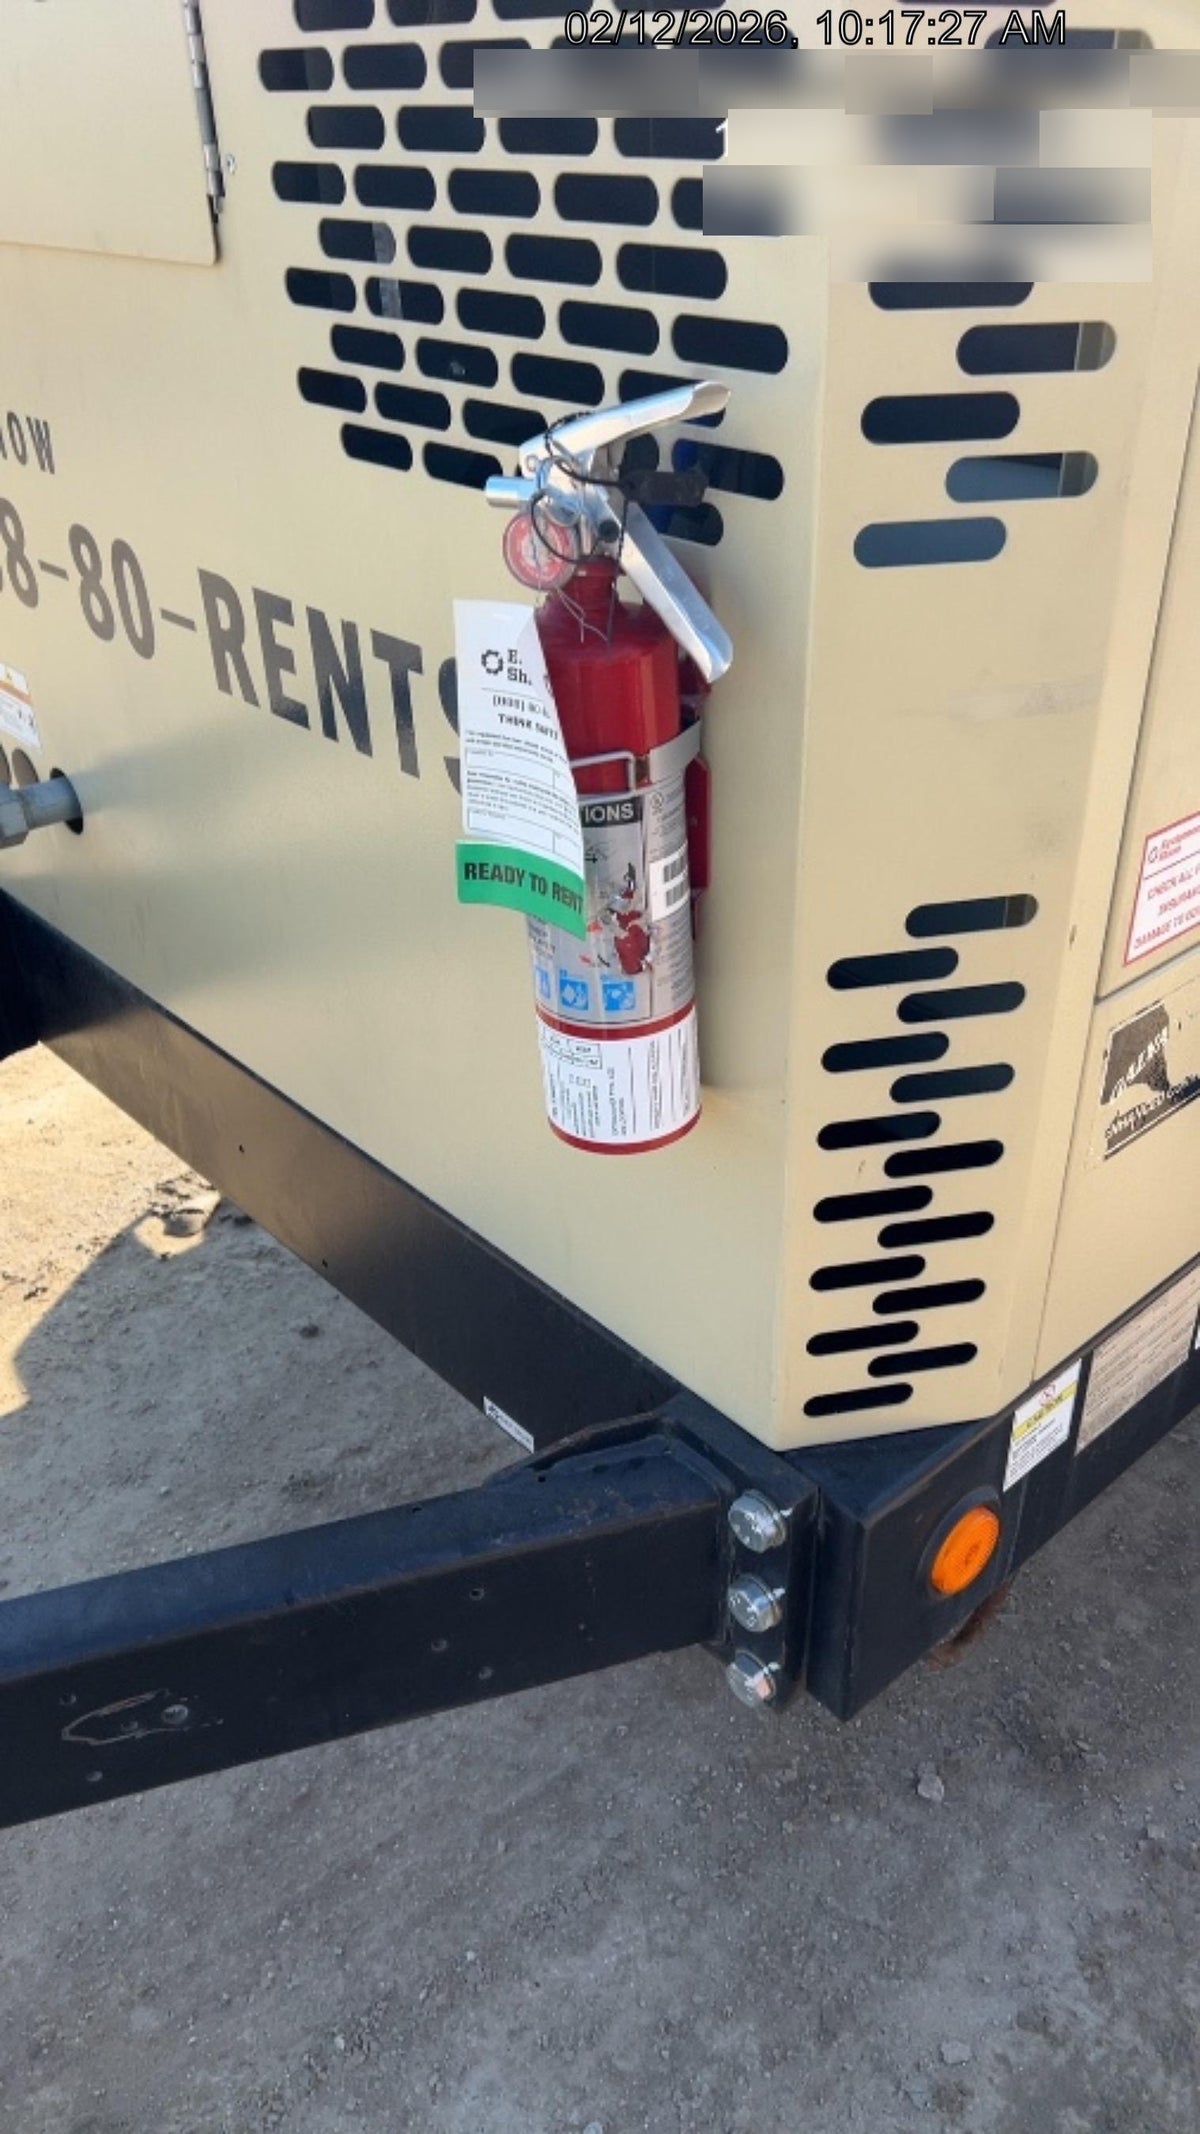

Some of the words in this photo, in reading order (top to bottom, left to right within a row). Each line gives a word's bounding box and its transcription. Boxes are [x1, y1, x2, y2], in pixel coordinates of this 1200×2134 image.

[0, 410, 55, 475] OW
[0, 497, 462, 797] 8-80-RENT
[582, 803, 634, 824] IONS
[463, 862, 525, 888] READY
[528, 872, 547, 896] TO
[552, 881, 584, 915] RENT
